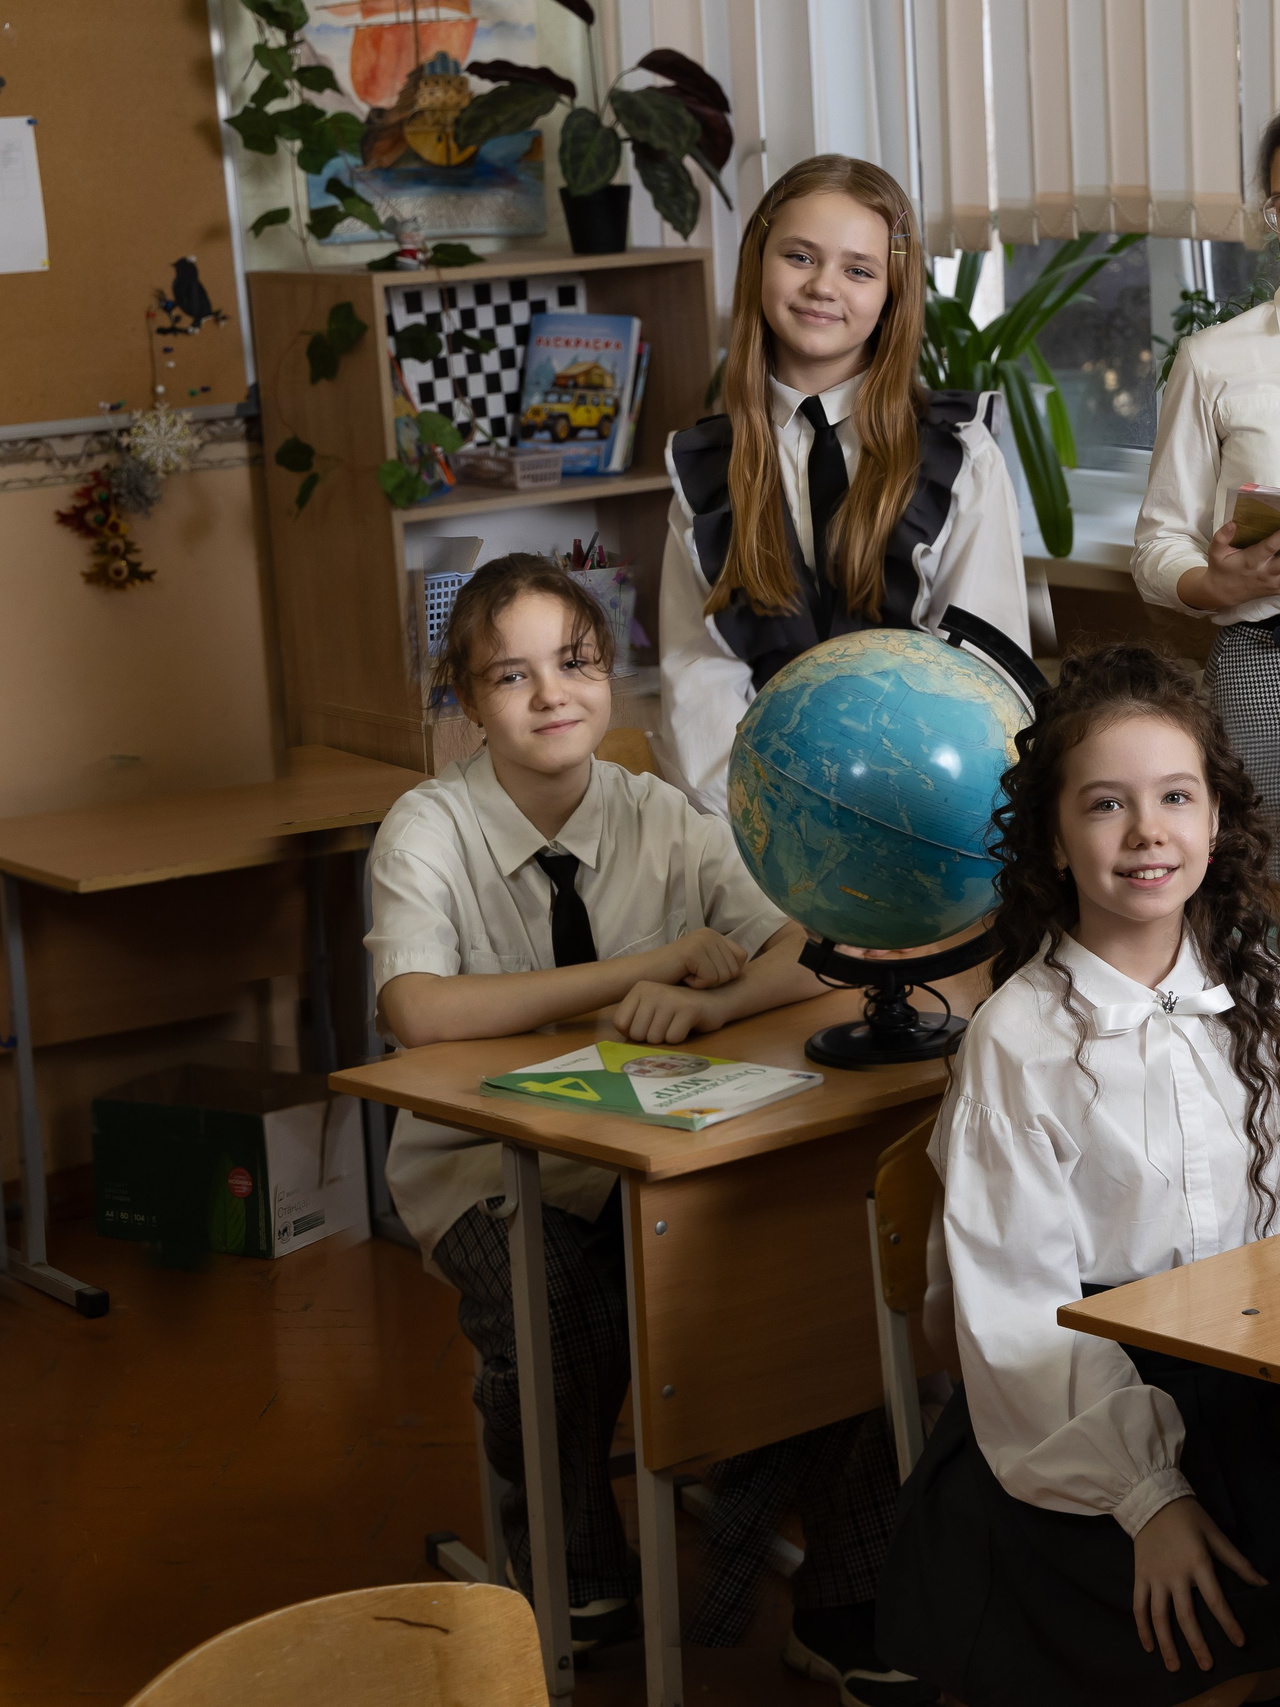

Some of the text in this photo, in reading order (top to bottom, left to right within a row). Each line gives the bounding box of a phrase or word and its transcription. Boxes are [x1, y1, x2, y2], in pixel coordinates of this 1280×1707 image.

[535, 336, 622, 351] РАСКРАСКА
[516, 1076, 602, 1102] 4
[651, 1076, 711, 1100] МИР
